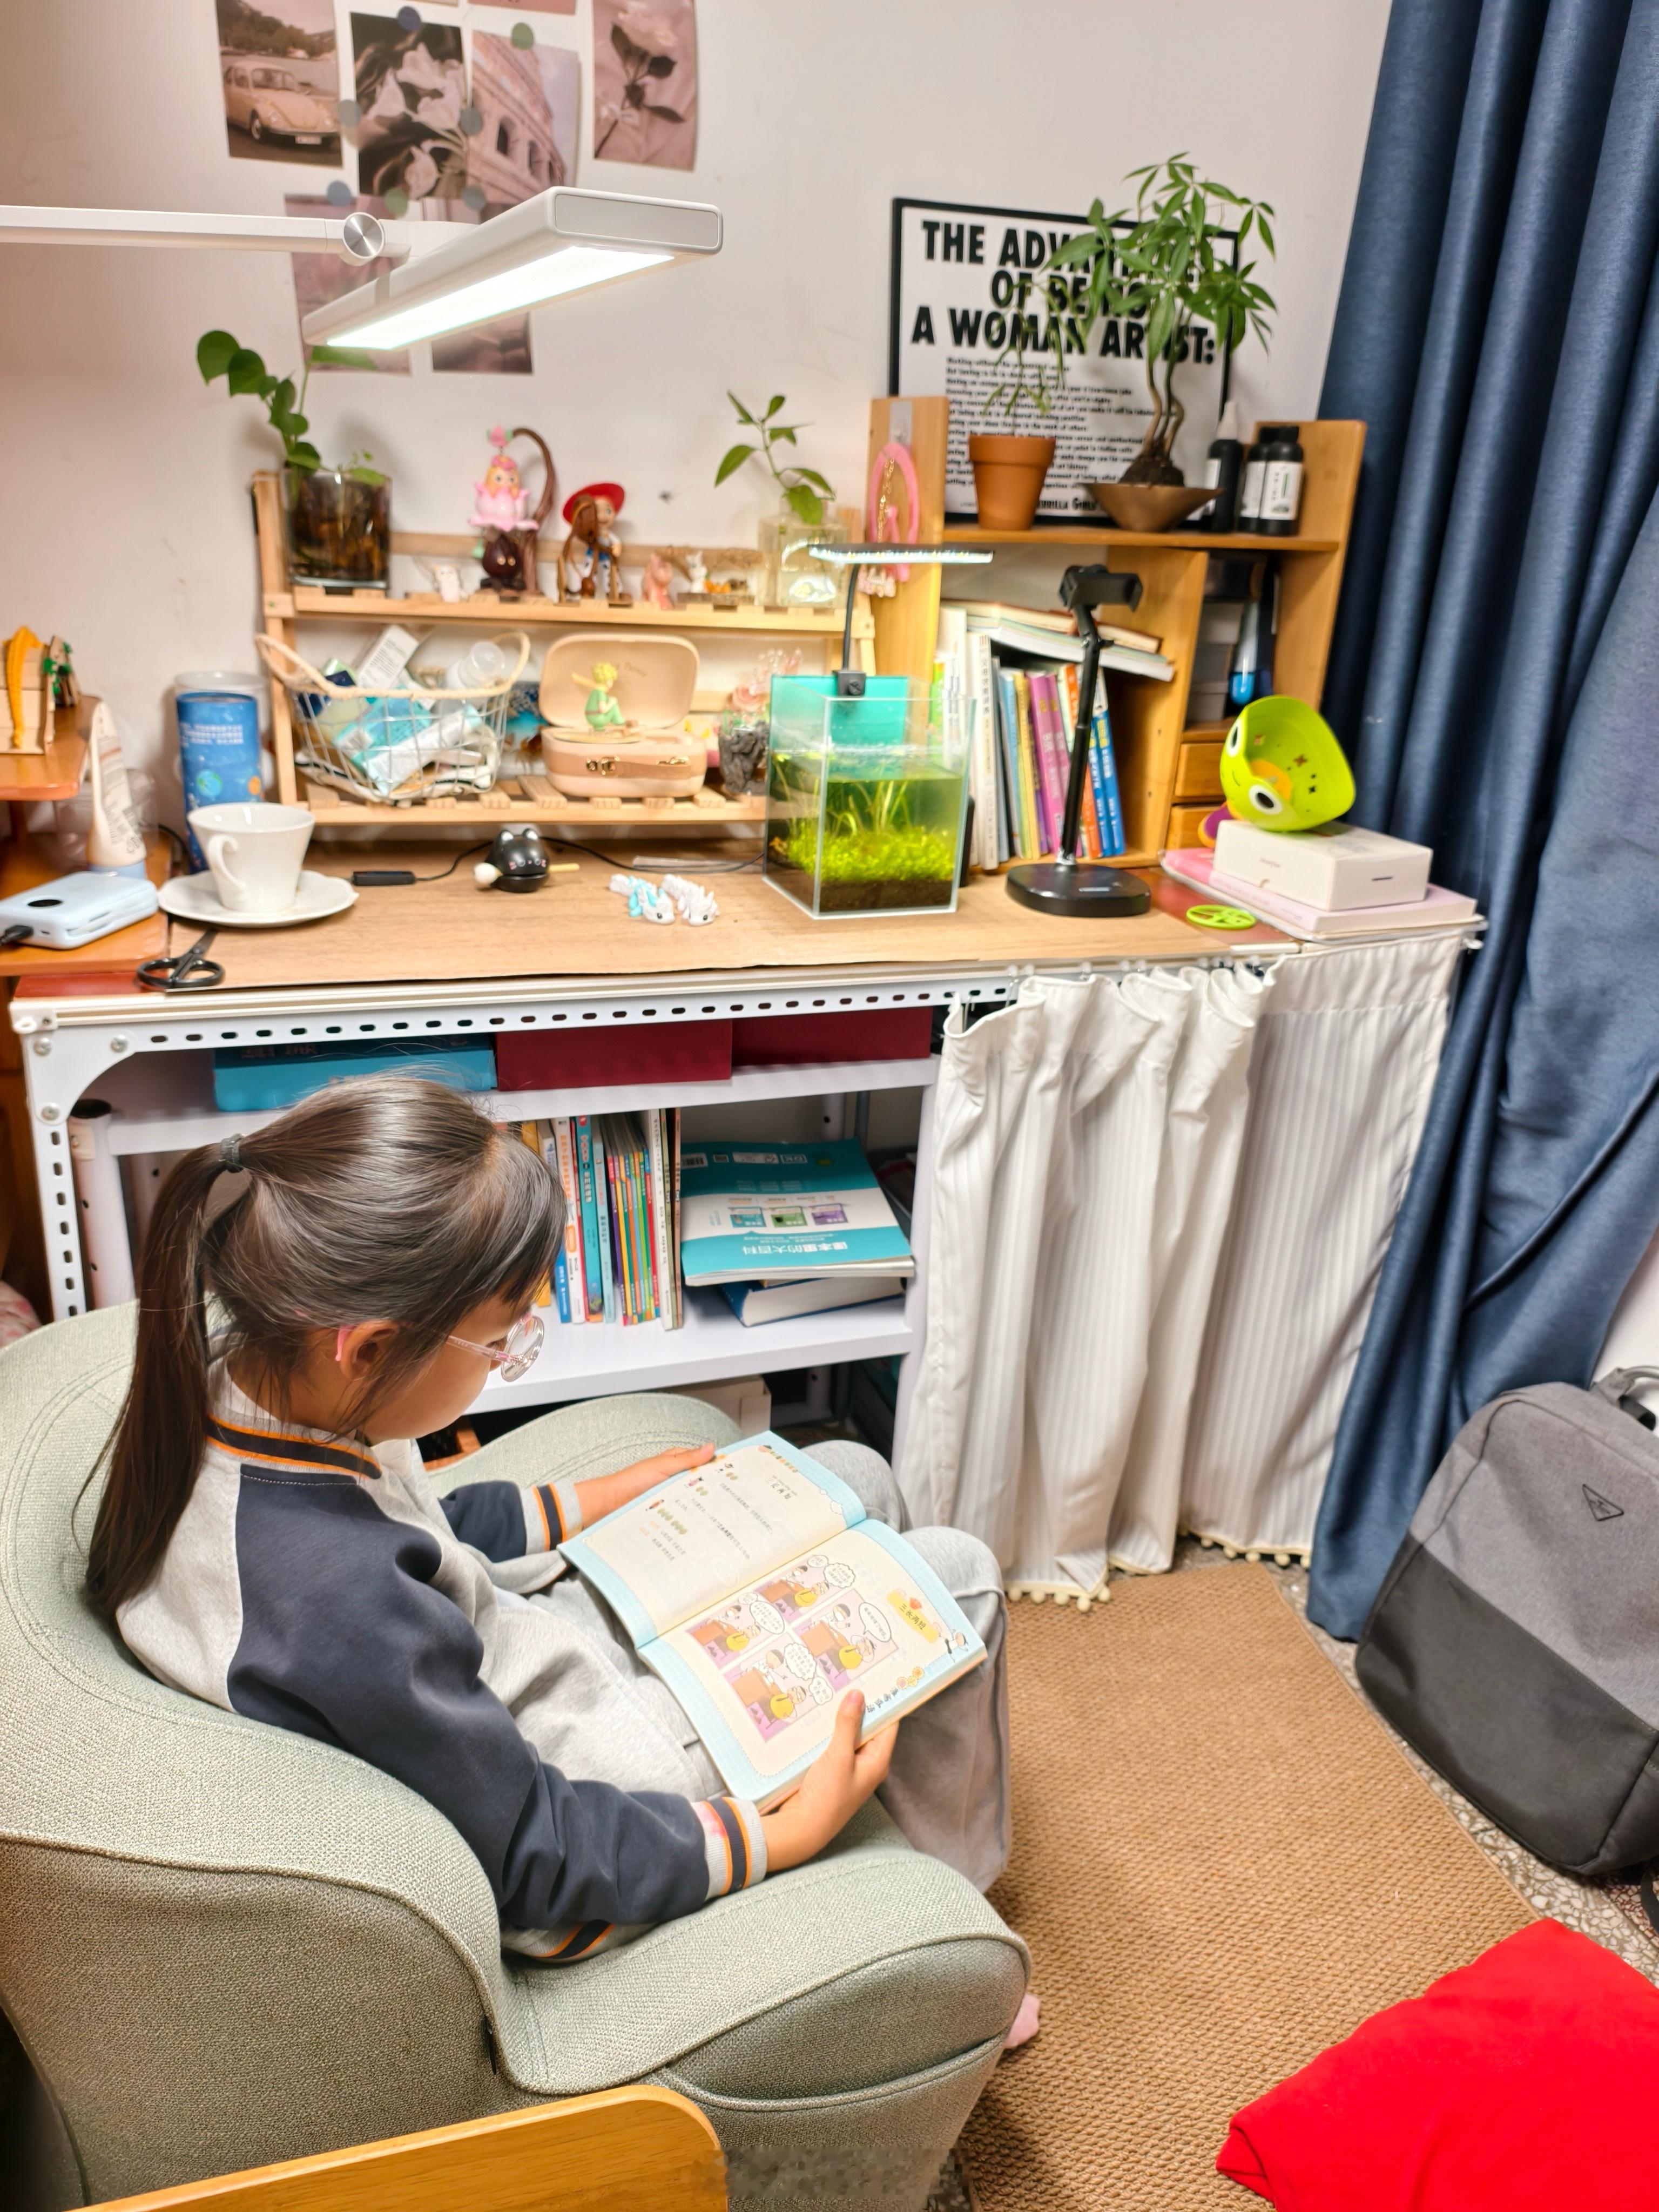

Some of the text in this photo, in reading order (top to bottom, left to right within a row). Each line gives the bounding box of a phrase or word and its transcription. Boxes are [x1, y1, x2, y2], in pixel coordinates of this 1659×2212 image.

[922, 220, 984, 265] THE
[992, 270, 1033, 309] OF
[912, 306, 936, 346] A
[948, 308, 1085, 355] WOMAN
[741, 1241, 848, 1255] 课本里的大百科
[899, 1603, 927, 1630] 三长两短
